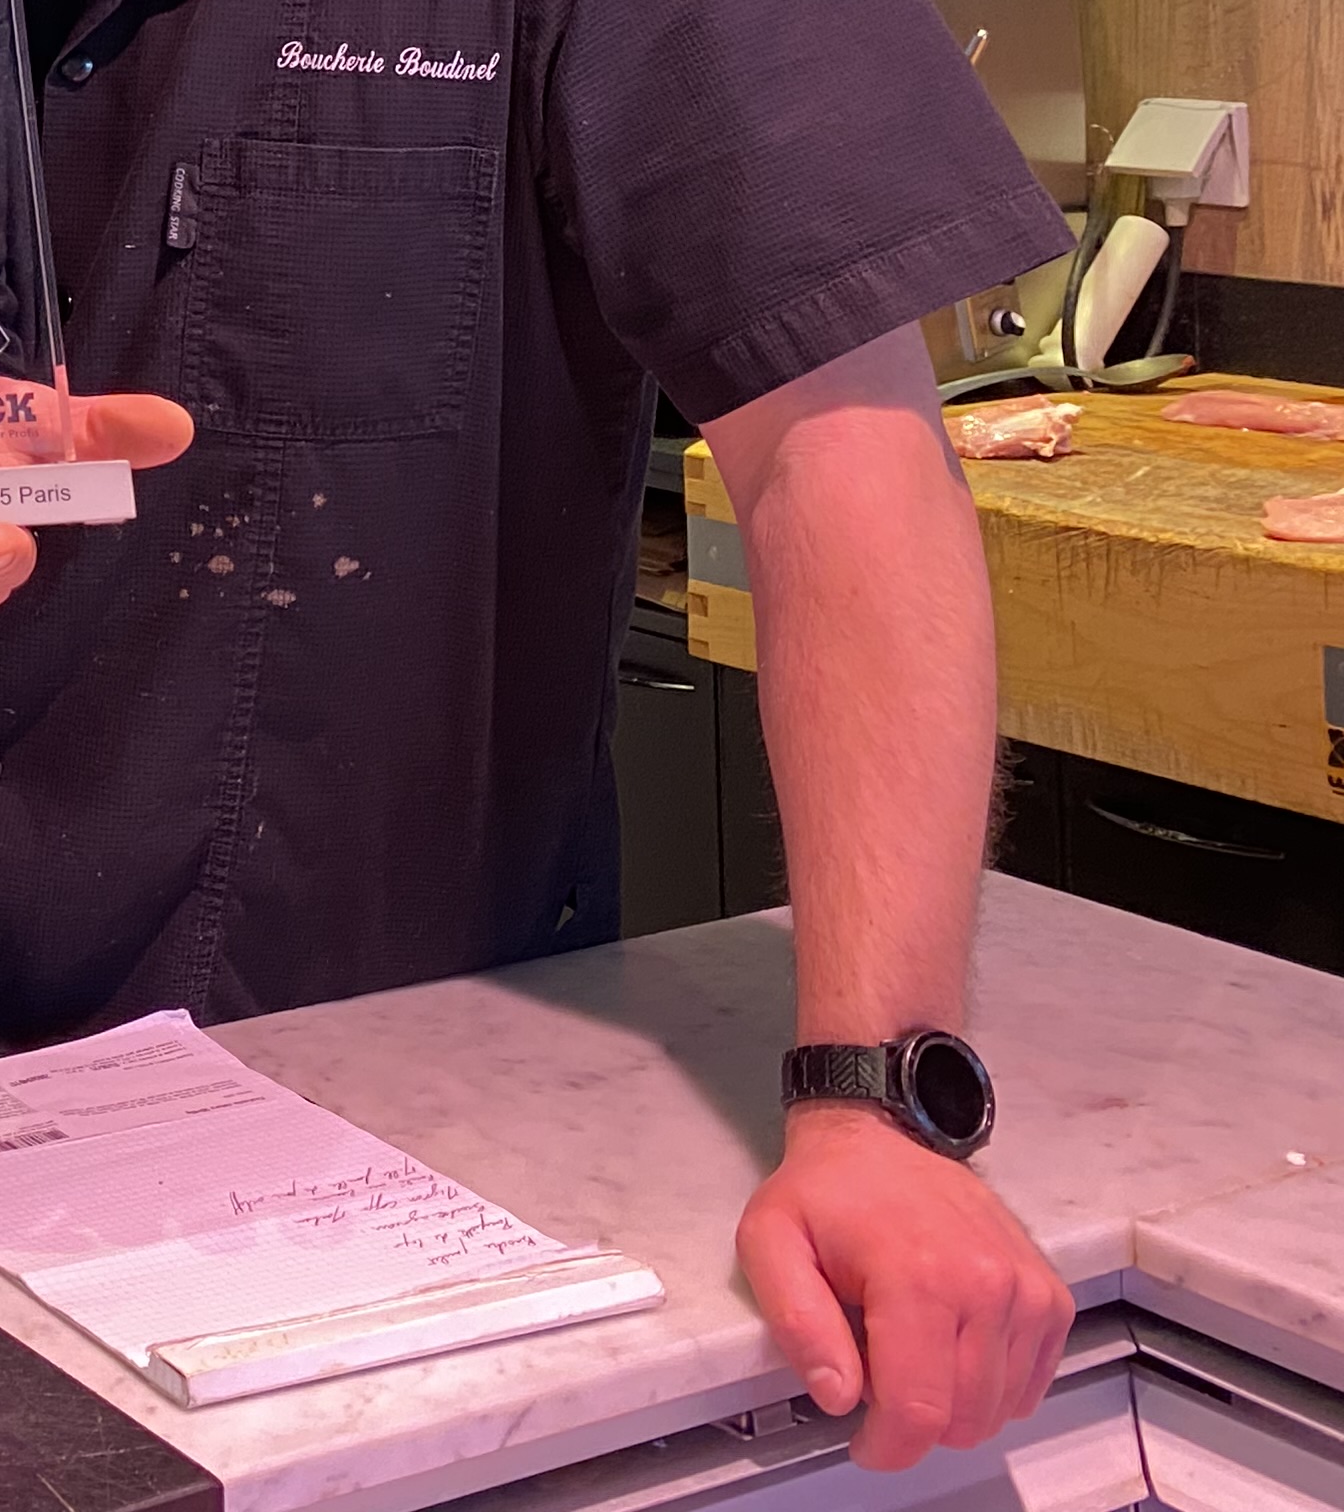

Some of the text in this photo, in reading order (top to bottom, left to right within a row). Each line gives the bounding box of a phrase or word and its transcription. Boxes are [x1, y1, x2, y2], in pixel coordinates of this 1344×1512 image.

[277, 40, 500, 81] Boucherie Boudinel
[168, 168, 186, 240] COOKING STAR
[19, 485, 72, 504] Paris
